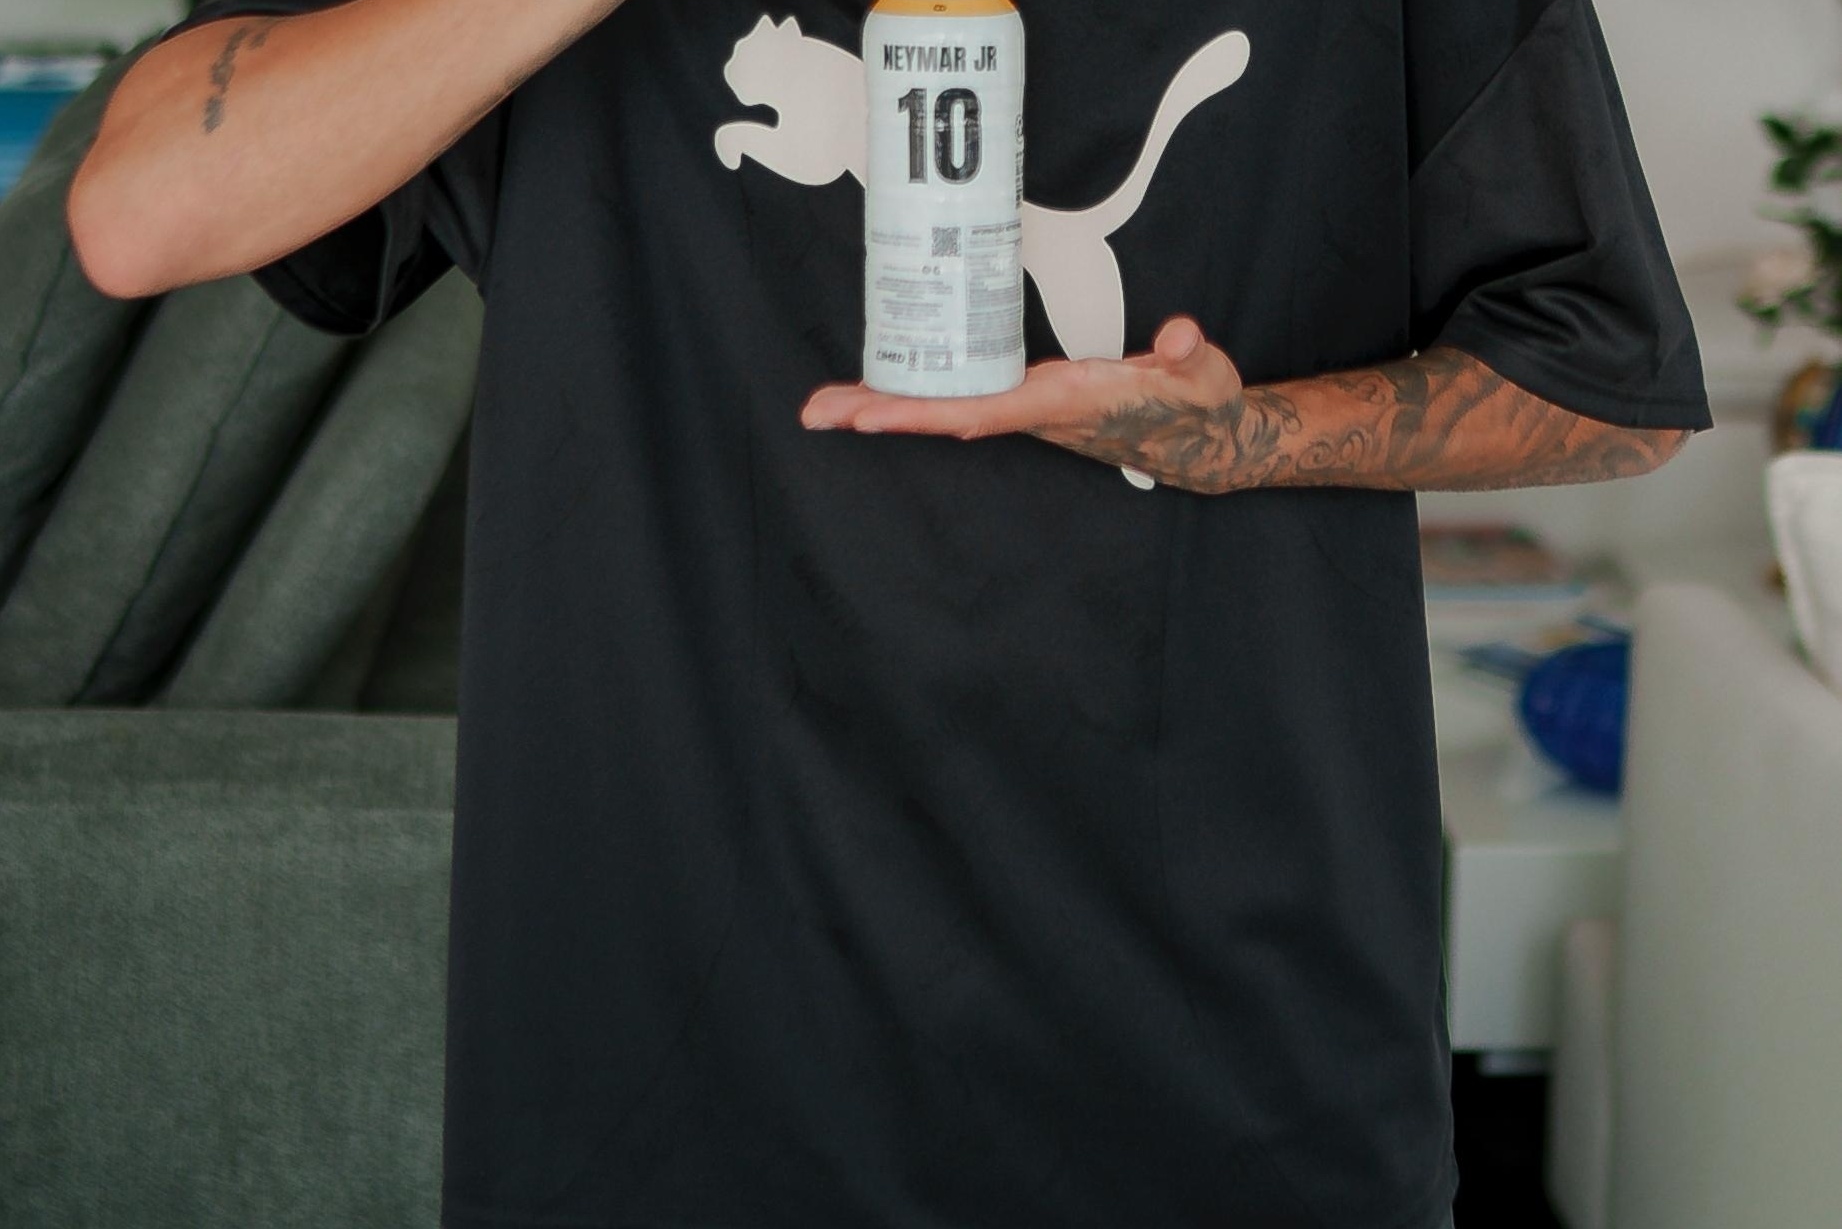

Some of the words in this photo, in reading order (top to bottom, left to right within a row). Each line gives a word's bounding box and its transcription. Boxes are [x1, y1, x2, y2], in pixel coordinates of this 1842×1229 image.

[883, 44, 966, 73] NEYMAR
[974, 45, 997, 72] JR
[898, 88, 982, 184] 10
